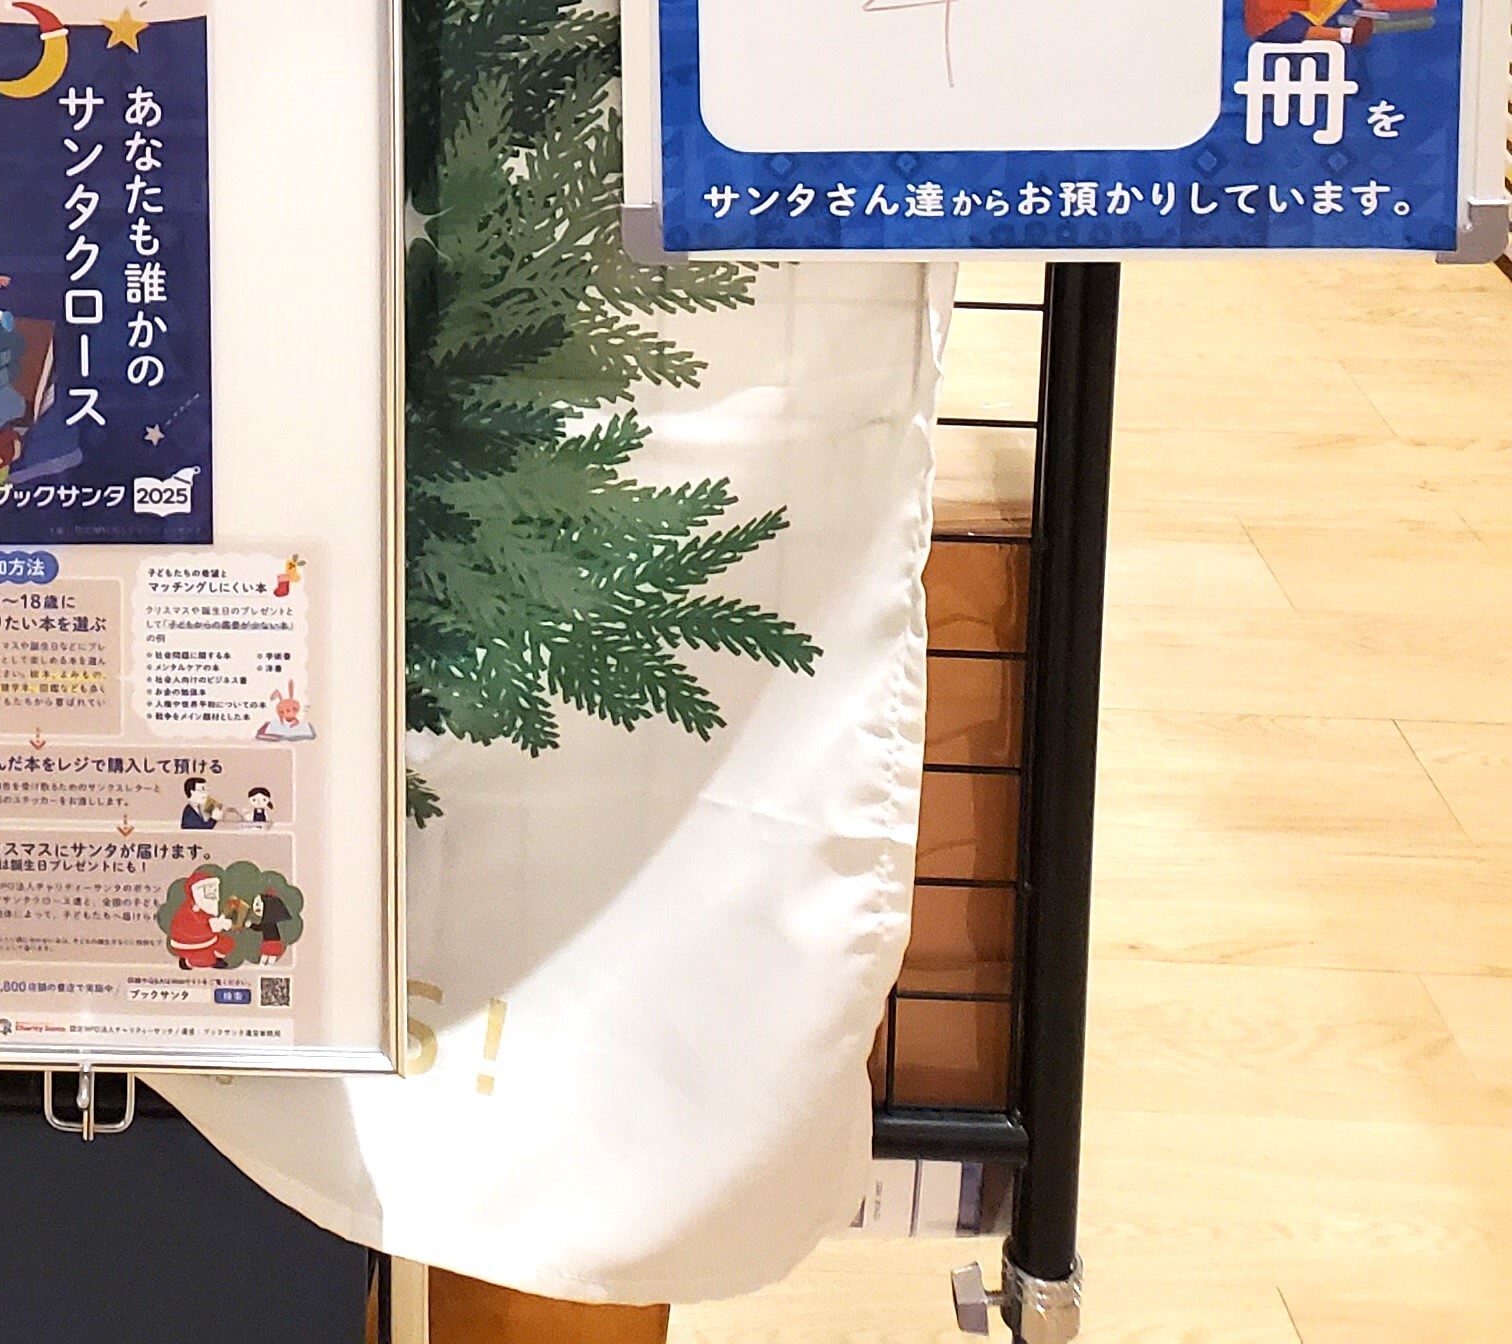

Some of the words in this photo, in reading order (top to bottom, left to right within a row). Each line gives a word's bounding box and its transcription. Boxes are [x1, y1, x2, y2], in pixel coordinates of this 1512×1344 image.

[703, 181, 1413, 220] サンタさん達からお預かりしています。
[125, 85, 167, 388] あなたも誰かの
[59, 86, 106, 427] サンタクロース
[136, 487, 189, 506] 2025
[148, 581, 268, 594] マッチングしにくい本
[130, 989, 189, 1000] ブックサンタ
